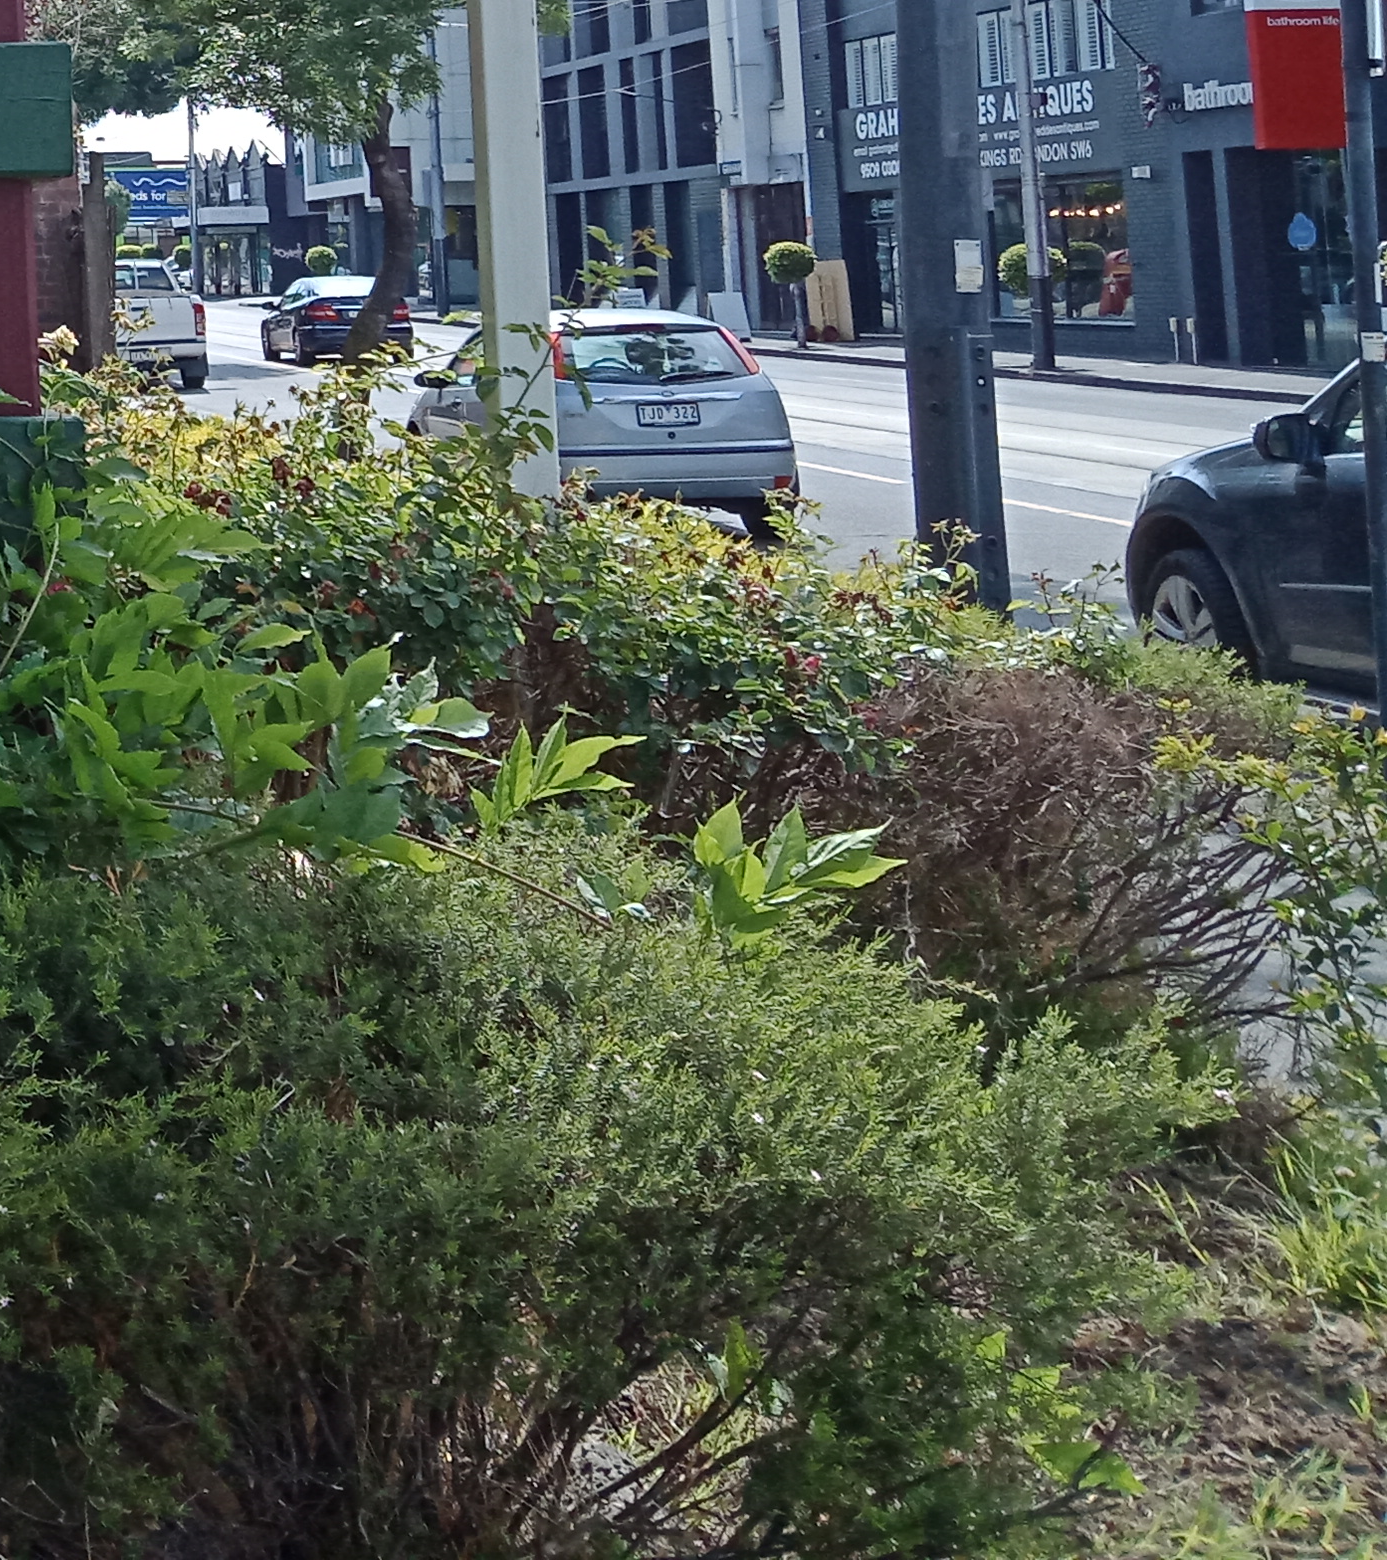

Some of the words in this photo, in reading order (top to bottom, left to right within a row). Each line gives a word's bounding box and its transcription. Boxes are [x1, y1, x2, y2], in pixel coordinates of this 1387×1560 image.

[1267, 16, 1322, 27] bathroom
[855, 108, 899, 140] GRAH
[976, 93, 998, 125] ES
[1034, 141, 1068, 162] NDON
[1070, 139, 1093, 160] SW6
[130, 190, 148, 201] eds
[151, 190, 166, 201] for
[640, 407, 664, 420] TJD
[673, 405, 697, 419] 322
